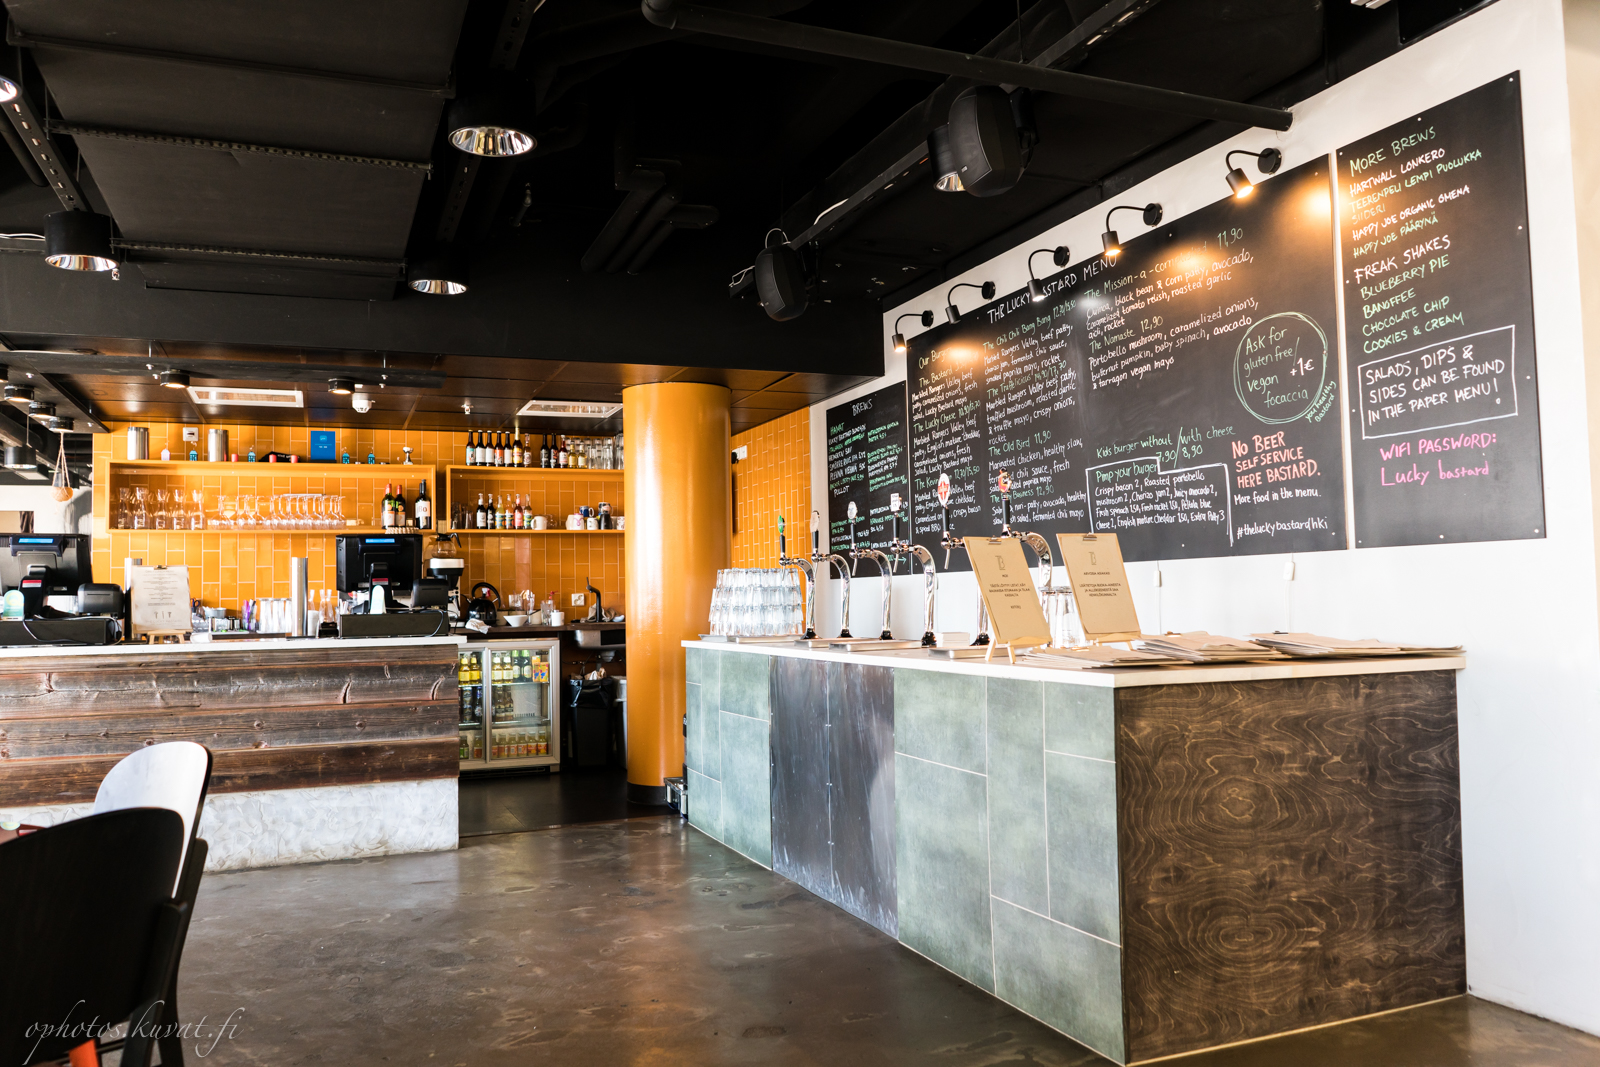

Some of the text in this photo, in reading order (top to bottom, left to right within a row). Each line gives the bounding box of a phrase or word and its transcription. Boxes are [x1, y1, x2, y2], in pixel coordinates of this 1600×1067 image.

[1350, 126, 1436, 177] MORE BREWS
[1350, 148, 1445, 197] HARTWALL LONKERO
[1405, 170, 1432, 188] LEMPI
[1436, 149, 1482, 174] PUOLUKKA
[1353, 185, 1470, 241] HAPPY JOE ORGANIC OMENA
[1353, 240, 1378, 258] HAPPY
[1381, 232, 1397, 245] JOE
[1354, 235, 1450, 284] FREAK SHAKES
[1115, 291, 1134, 306] black
[1136, 284, 1153, 298] bean
[1165, 275, 1182, 286] corn
[1212, 248, 1254, 272] avocado,
[1361, 254, 1450, 300] BLUEBERRY PIE
[1007, 292, 1030, 314] LUCKY
[1042, 273, 1077, 297] STARD
[1084, 289, 1101, 299] The
[1122, 301, 1145, 315] tomato
[1172, 281, 1202, 298] roasted
[1207, 271, 1232, 290] garlic
[1363, 288, 1416, 319] BANOFFEE
[1103, 318, 1126, 333] rocket
[1363, 296, 1450, 336] CHOCOLATE CHIP
[983, 342, 994, 353] The
[1088, 296, 1259, 371] Portobello mushroom, caramelized onions,
[1089, 316, 1163, 353] The Namaste 12,90
[1121, 350, 1154, 368] pumpkin,
[1155, 342, 1173, 354] baby
[1175, 329, 1209, 348] spinach,
[1213, 315, 1252, 336] avocado
[1246, 326, 1287, 355] Ask for
[1364, 312, 1464, 354] COOKIES & CREAM
[1099, 372, 1128, 386] tarragon
[1130, 362, 1151, 380] vegan
[1154, 356, 1174, 370] mayo
[1244, 354, 1273, 377] gluten
[1366, 345, 1473, 385] SALADS, DIPS &
[987, 388, 998, 399] The
[1247, 375, 1278, 394] vegan
[1370, 359, 1505, 403] SIDES CAN BE FOUND
[852, 399, 873, 417] BREWS
[1264, 385, 1308, 408] focaccia
[1368, 409, 1380, 425] IN
[1382, 403, 1406, 419] THE
[1409, 392, 1448, 412] PAPER
[988, 447, 1001, 457] The
[1003, 443, 1013, 452] Old
[1016, 437, 1030, 450] Bird
[1097, 448, 1112, 458] Kids
[1114, 442, 1140, 456] burger
[1207, 426, 1236, 438] cheese
[1252, 431, 1285, 452] BEER
[1380, 433, 1497, 461] WIFI PASSWORD:
[1053, 459, 1070, 473] fresh
[1096, 462, 1157, 483] Pimp your burger
[1236, 447, 1304, 472] SELF SERVICE
[1237, 459, 1321, 488] HERE BASTARD.
[1382, 459, 1489, 486] Lucky bastard
[1095, 487, 1114, 496] Crispy
[1115, 483, 1133, 491] bacon
[1145, 476, 1170, 486] Roasted
[1234, 494, 1251, 505] More
[1253, 491, 1269, 504] food
[1272, 491, 1278, 500] in
[1280, 487, 1293, 499] the
